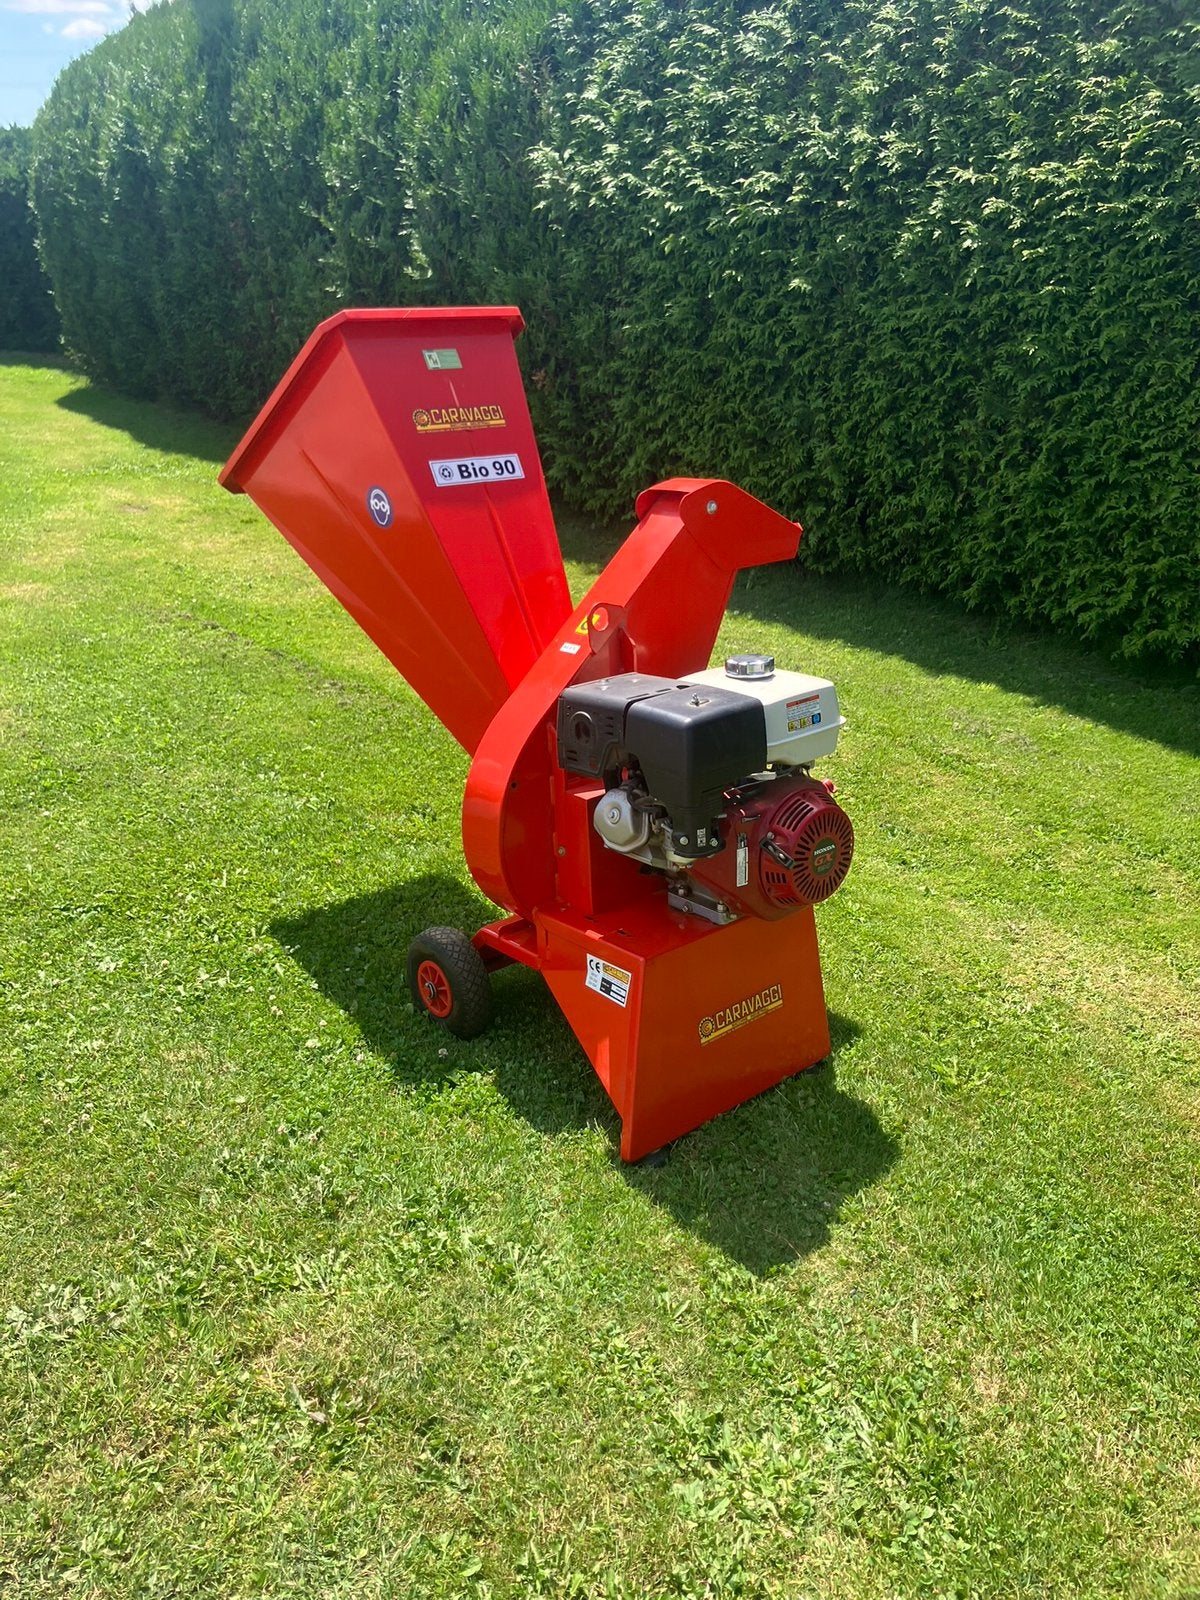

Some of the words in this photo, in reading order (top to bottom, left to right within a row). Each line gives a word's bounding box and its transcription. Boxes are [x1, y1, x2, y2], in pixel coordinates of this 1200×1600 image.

[430, 405, 504, 424] CARAVAGGI
[457, 463, 489, 479] Bio
[493, 460, 516, 476] 90
[814, 844, 836, 856] HONDA
[716, 984, 782, 1029] CARAVAGGI
